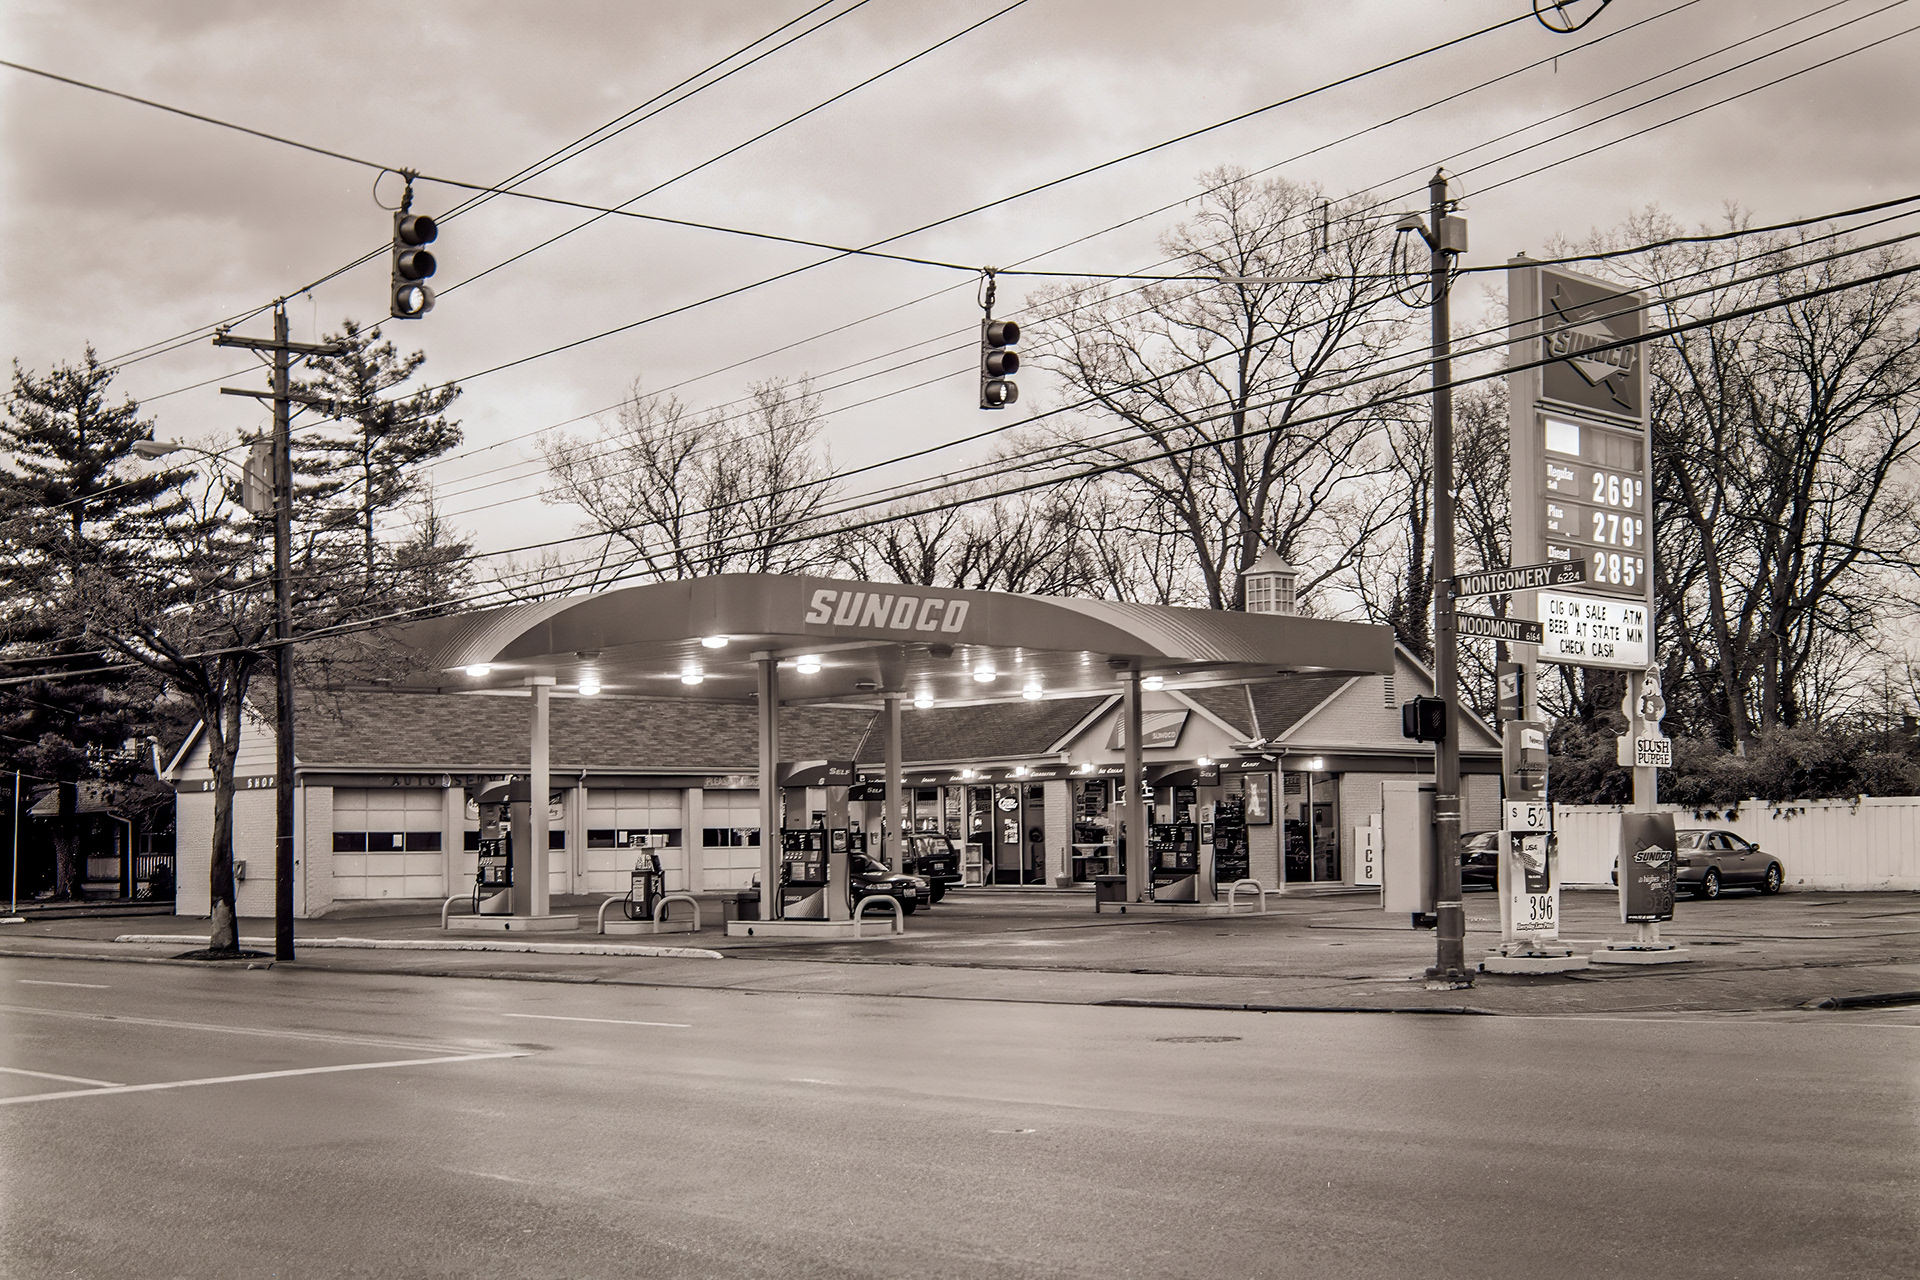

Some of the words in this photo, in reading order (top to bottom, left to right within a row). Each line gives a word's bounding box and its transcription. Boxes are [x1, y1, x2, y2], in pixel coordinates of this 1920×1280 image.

[1547, 464, 1574, 481] Regular
[1547, 504, 1564, 518] Plus
[1547, 545, 1571, 560] Diesel
[1460, 566, 1552, 596] MONTGOMERY
[1556, 571, 1580, 583] 6224
[805, 590, 970, 633] SUNOCO
[1550, 600, 1564, 616] CIG
[1568, 602, 1580, 618] ON
[1585, 604, 1607, 621] SALE
[1622, 608, 1643, 626] ATM
[1457, 614, 1522, 639] WOODMONT
[1525, 631, 1541, 641] 6164
[1549, 618, 1569, 635] BEER
[1575, 622, 1587, 637] AT
[1592, 624, 1620, 641] STATE
[1626, 627, 1643, 643] MIN
[1559, 638, 1586, 656] CHECK
[1592, 642, 1615, 658] CASH
[1152, 731, 1176, 739] SUNOCO
[1637, 740, 1669, 754] SLUSH
[247, 776, 275, 789] SHOP
[393, 773, 436, 787] AUTO
[1512, 807, 1518, 818] $
[1525, 843, 1538, 851] USA
[1636, 851, 1671, 862] SUNOCO
